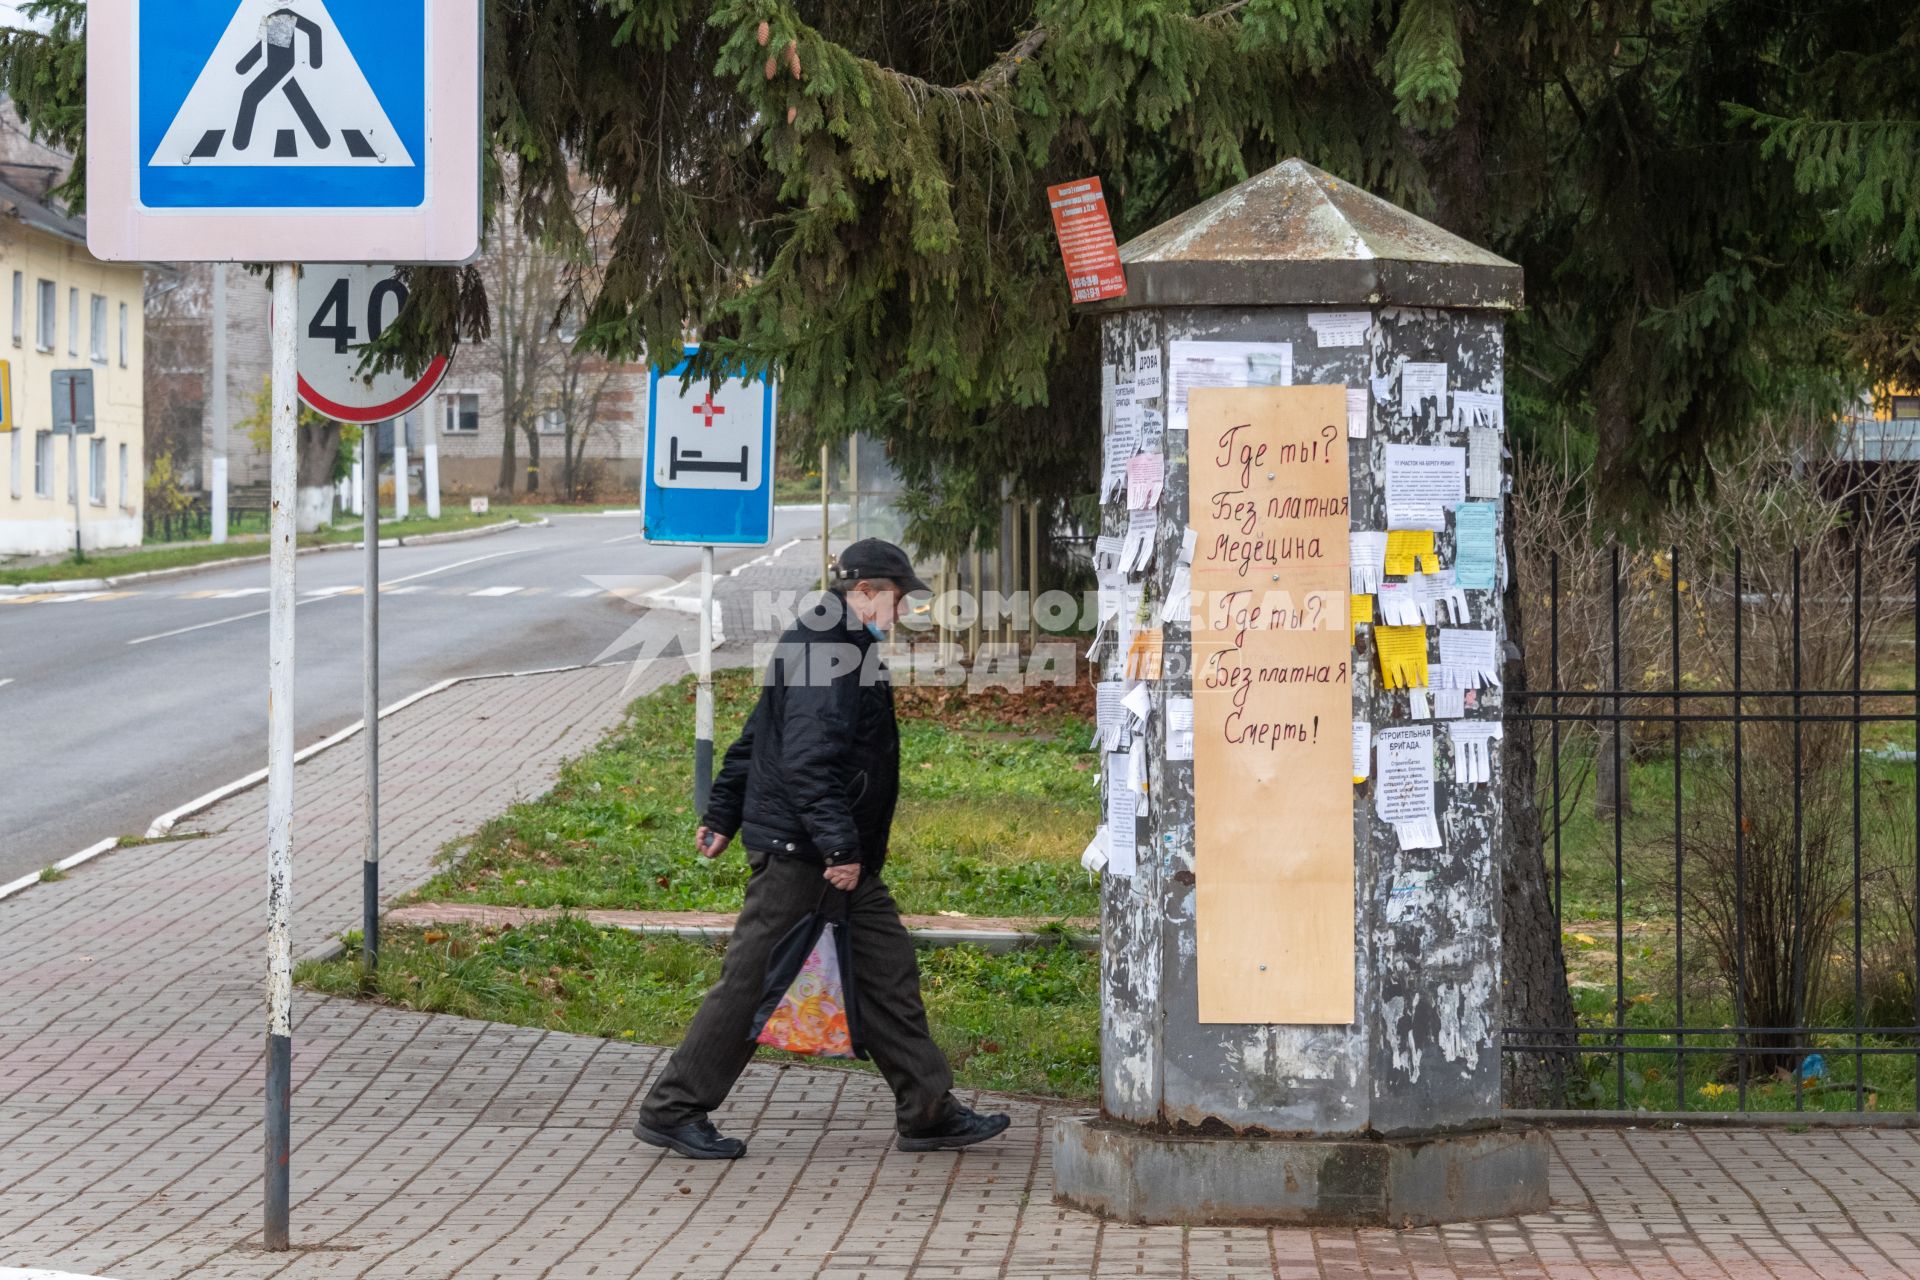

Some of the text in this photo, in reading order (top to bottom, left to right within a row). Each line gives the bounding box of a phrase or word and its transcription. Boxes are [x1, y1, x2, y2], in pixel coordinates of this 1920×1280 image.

[1216, 424, 1267, 489] Где
[1280, 425, 1338, 465] ты?
[1212, 490, 1349, 535] Без платная
[1214, 589, 1322, 648] Где ты?
[1206, 648, 1252, 707] Без
[1224, 706, 1319, 751] Смерть!
[1379, 729, 1431, 741] СТРОИТЕЛЬНАЯ
